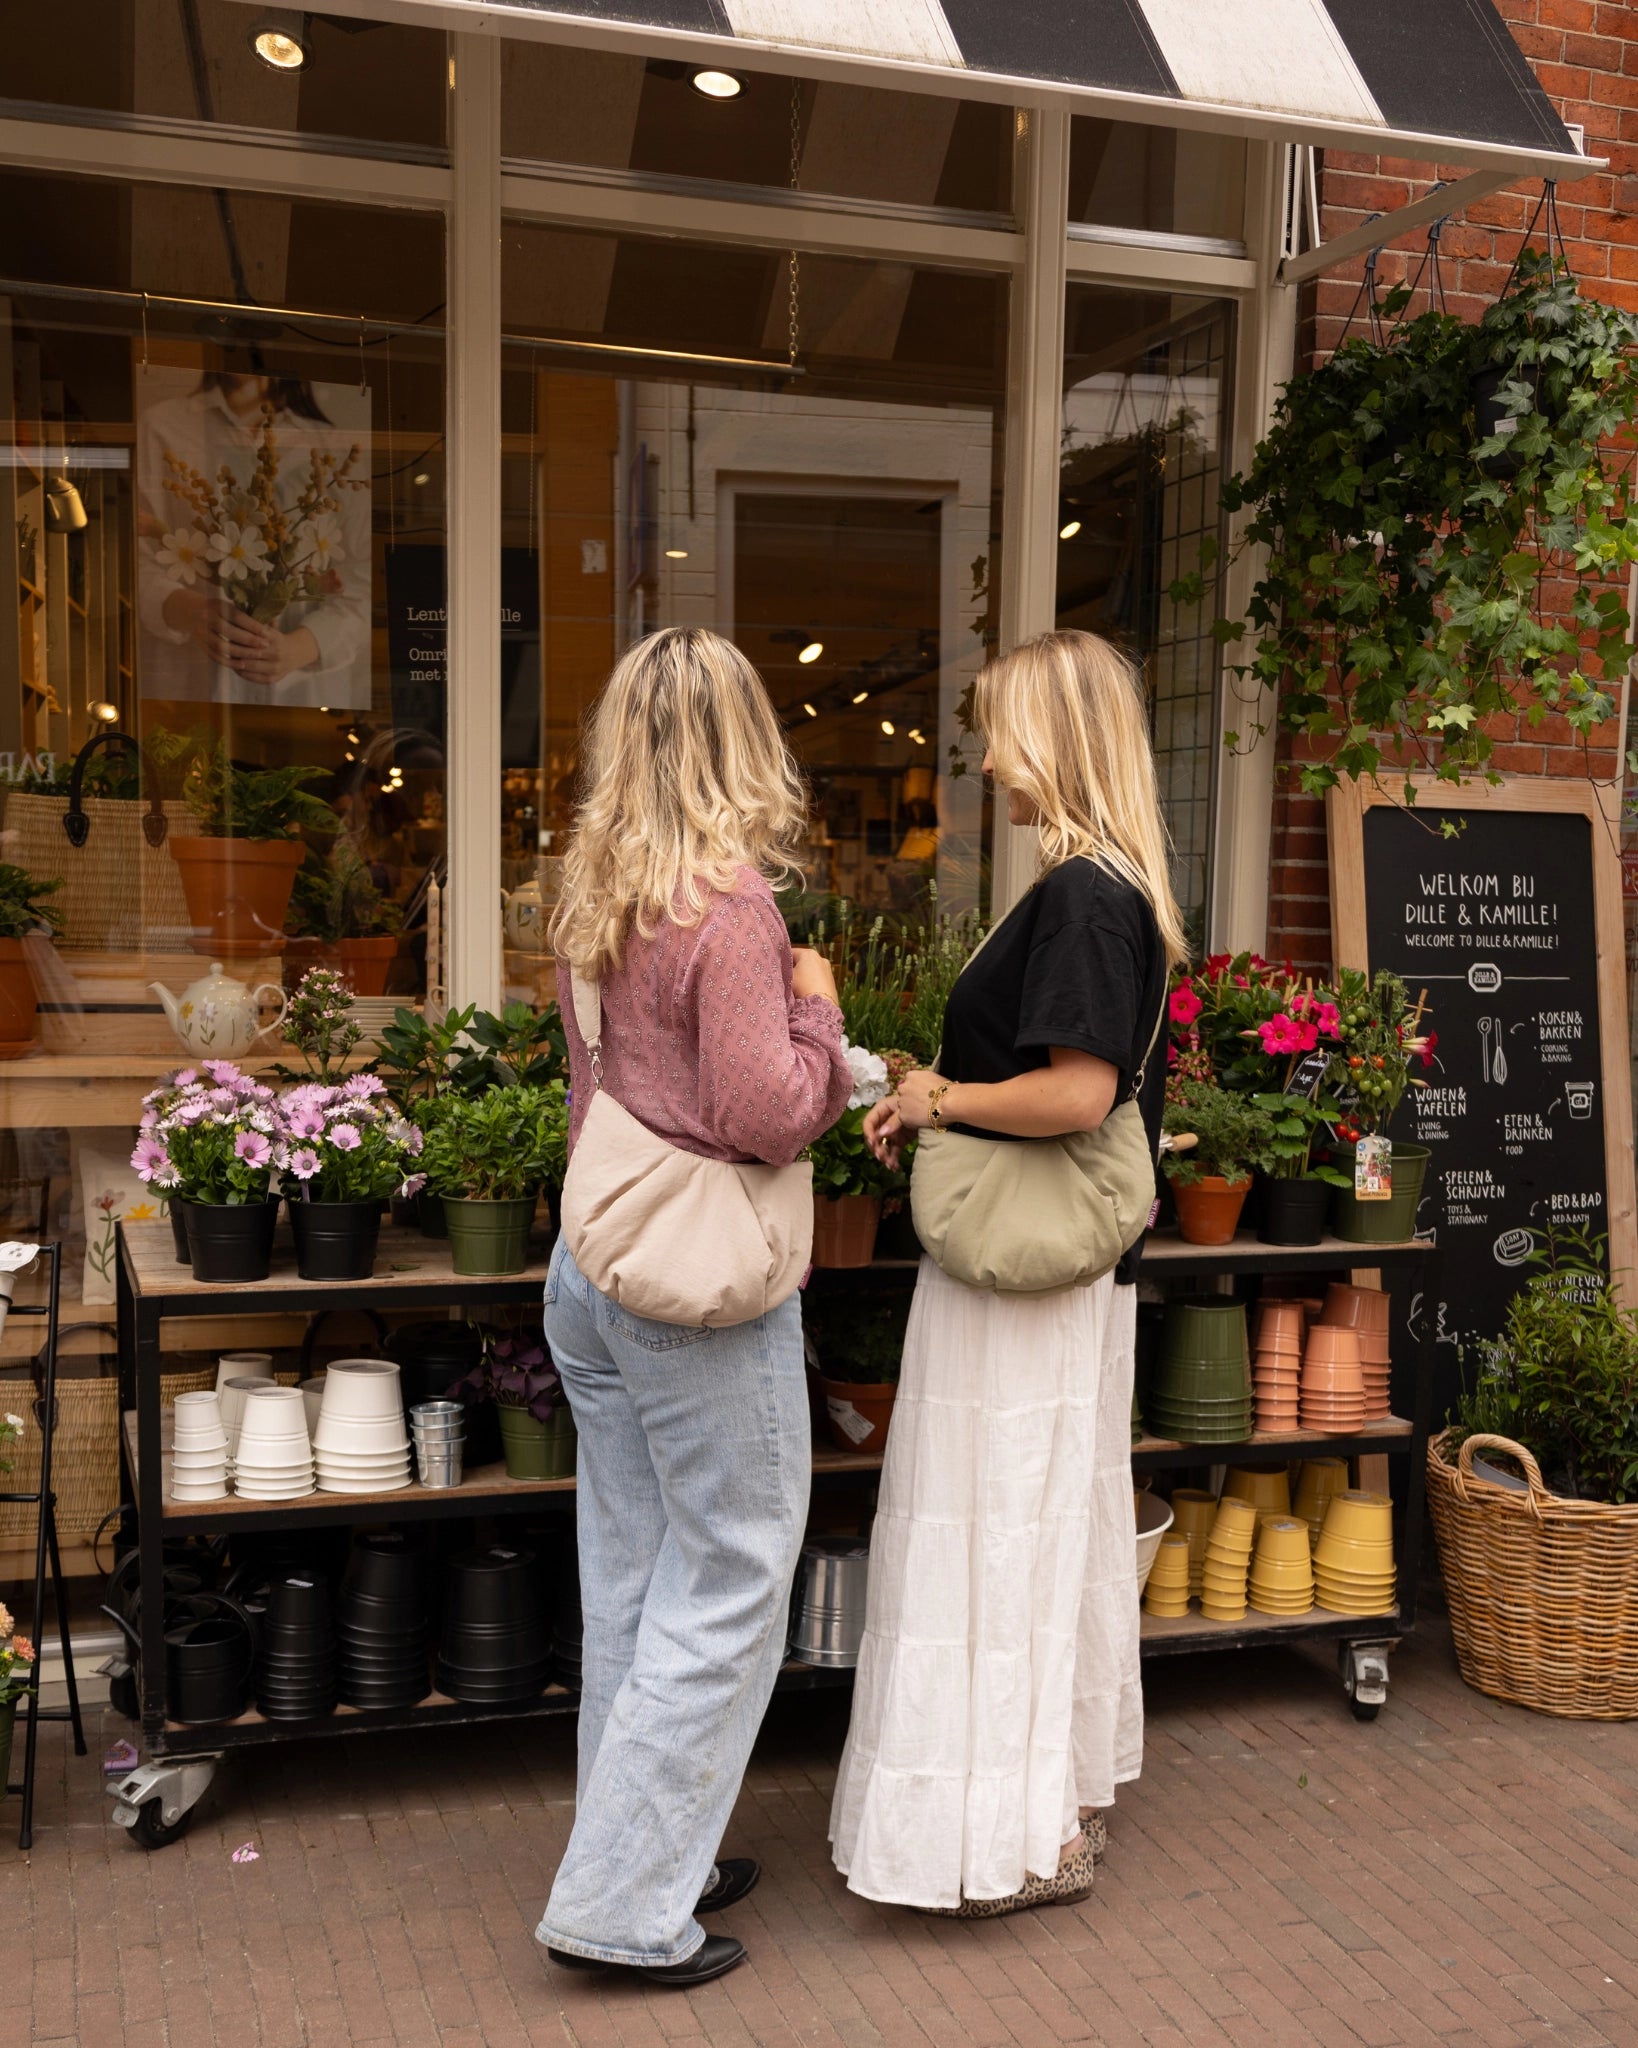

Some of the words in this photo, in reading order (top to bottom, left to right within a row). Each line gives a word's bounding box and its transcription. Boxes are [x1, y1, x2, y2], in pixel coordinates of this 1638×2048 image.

[406, 607, 448, 621] Lent
[409, 648, 448, 661] Omri
[410, 669, 441, 681] met
[1419, 873, 1499, 897] WELKOM
[1512, 874, 1534, 898] BIJ
[1405, 903, 1447, 924] DILLE
[1458, 903, 1472, 926] &
[1480, 903, 1557, 925] KAMILLE!
[1405, 934, 1455, 947] WELCOME
[1459, 934, 1472, 947] TO
[1540, 1025, 1582, 1040] BAKKEN
[1540, 1044, 1569, 1053] COOKING
[1416, 1101, 1467, 1117] TAFELEN
[1417, 1121, 1441, 1131] LIVING
[1504, 1114, 1532, 1128] ETEN
[1535, 1113, 1544, 1127] &
[1505, 1127, 1553, 1141] DRINKEN
[1505, 1144, 1524, 1155] FOOD
[1446, 1184, 1505, 1200] SCHRIJVEN
[1447, 1205, 1463, 1215] TOYS
[1464, 1204, 1472, 1214] &
[1447, 1214, 1489, 1226] STATIONARY
[1504, 1232, 1521, 1246] SOAP
